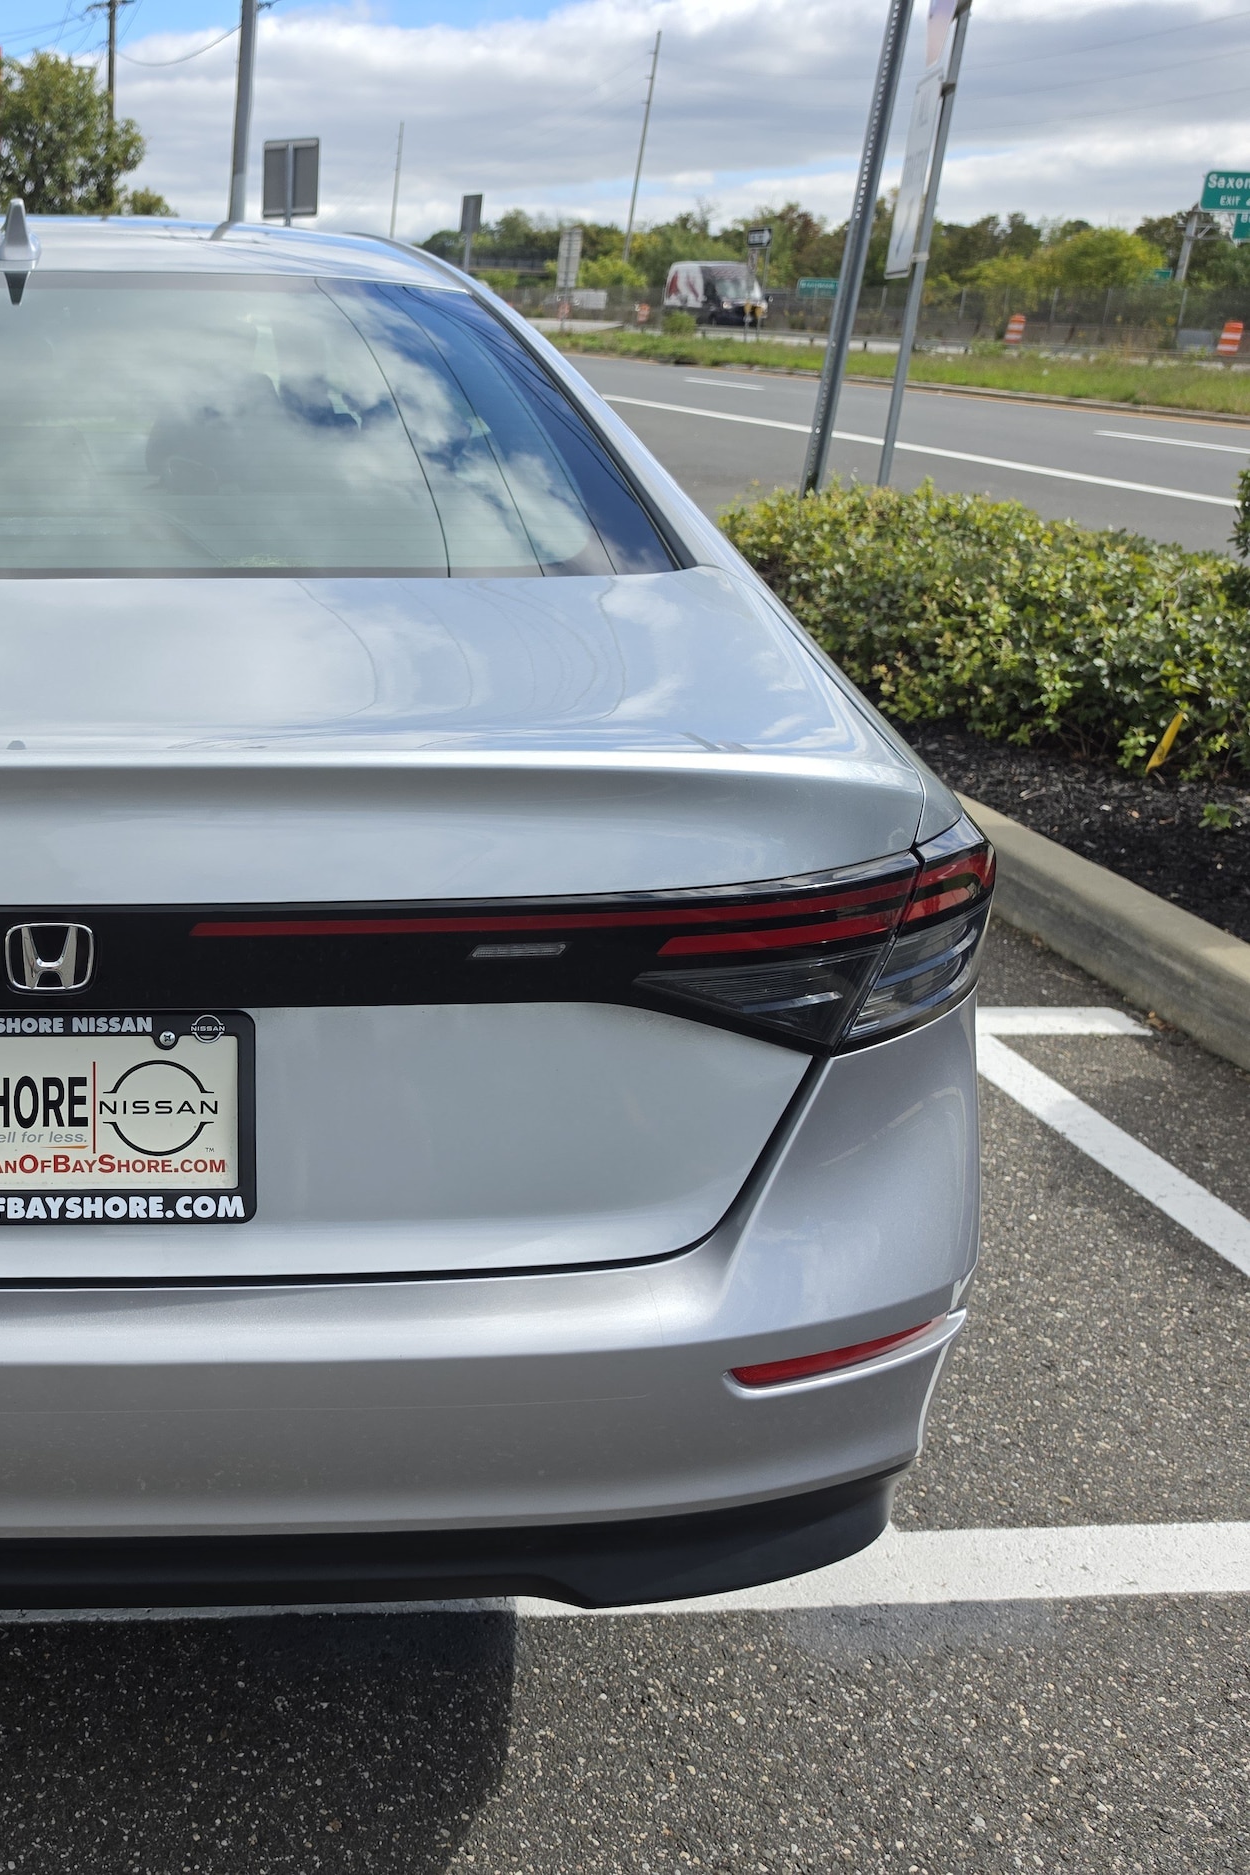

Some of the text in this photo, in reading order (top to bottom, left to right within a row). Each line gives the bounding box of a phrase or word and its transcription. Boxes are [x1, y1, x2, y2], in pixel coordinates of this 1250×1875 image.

[1219, 194, 1241, 206] EXIT
[71, 1016, 153, 1033] NISSAN
[99, 1100, 218, 1115] NISSAN
[21, 1131, 44, 1143] for
[48, 1131, 87, 1143] less.
